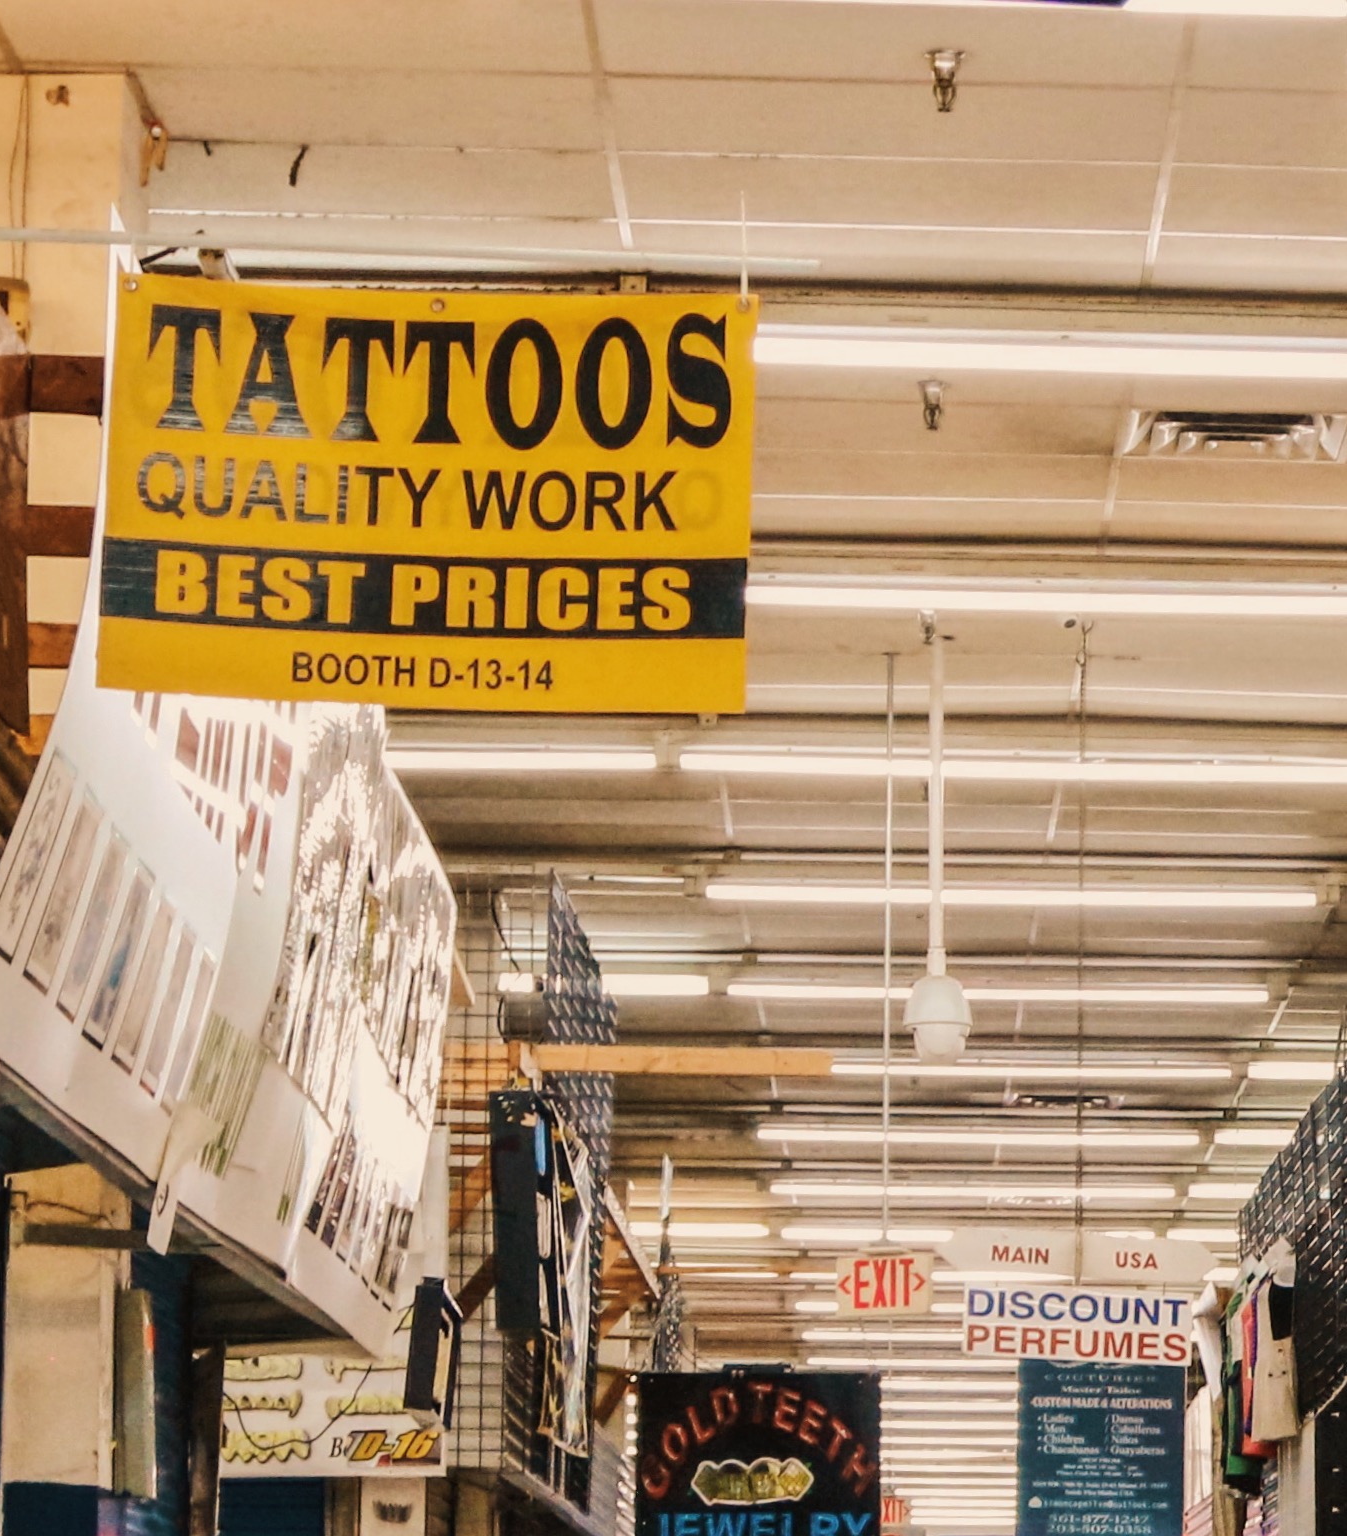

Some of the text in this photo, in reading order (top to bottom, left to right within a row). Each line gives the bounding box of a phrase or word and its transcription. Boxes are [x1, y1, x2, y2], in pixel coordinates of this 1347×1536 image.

[147, 304, 732, 450] TATTOOS
[137, 452, 679, 531] QUALITY WORK
[155, 549, 691, 631] BEST PRICES
[293, 652, 553, 691] BOOTH D-13-14
[991, 1245, 1049, 1265] MAIN
[1116, 1251, 1158, 1270] USA
[853, 1258, 915, 1309] EXIT
[968, 1288, 1188, 1327] DISCOUNT
[966, 1325, 1187, 1362] PERFUMES
[1043, 1413, 1074, 1423] Ladies
[1044, 1424, 1066, 1433] Men
[351, 1430, 439, 1461] D-16
[641, 1382, 878, 1499] GOLD TEETH
[1043, 1434, 1085, 1444] Children
[883, 1499, 905, 1523] XIT
